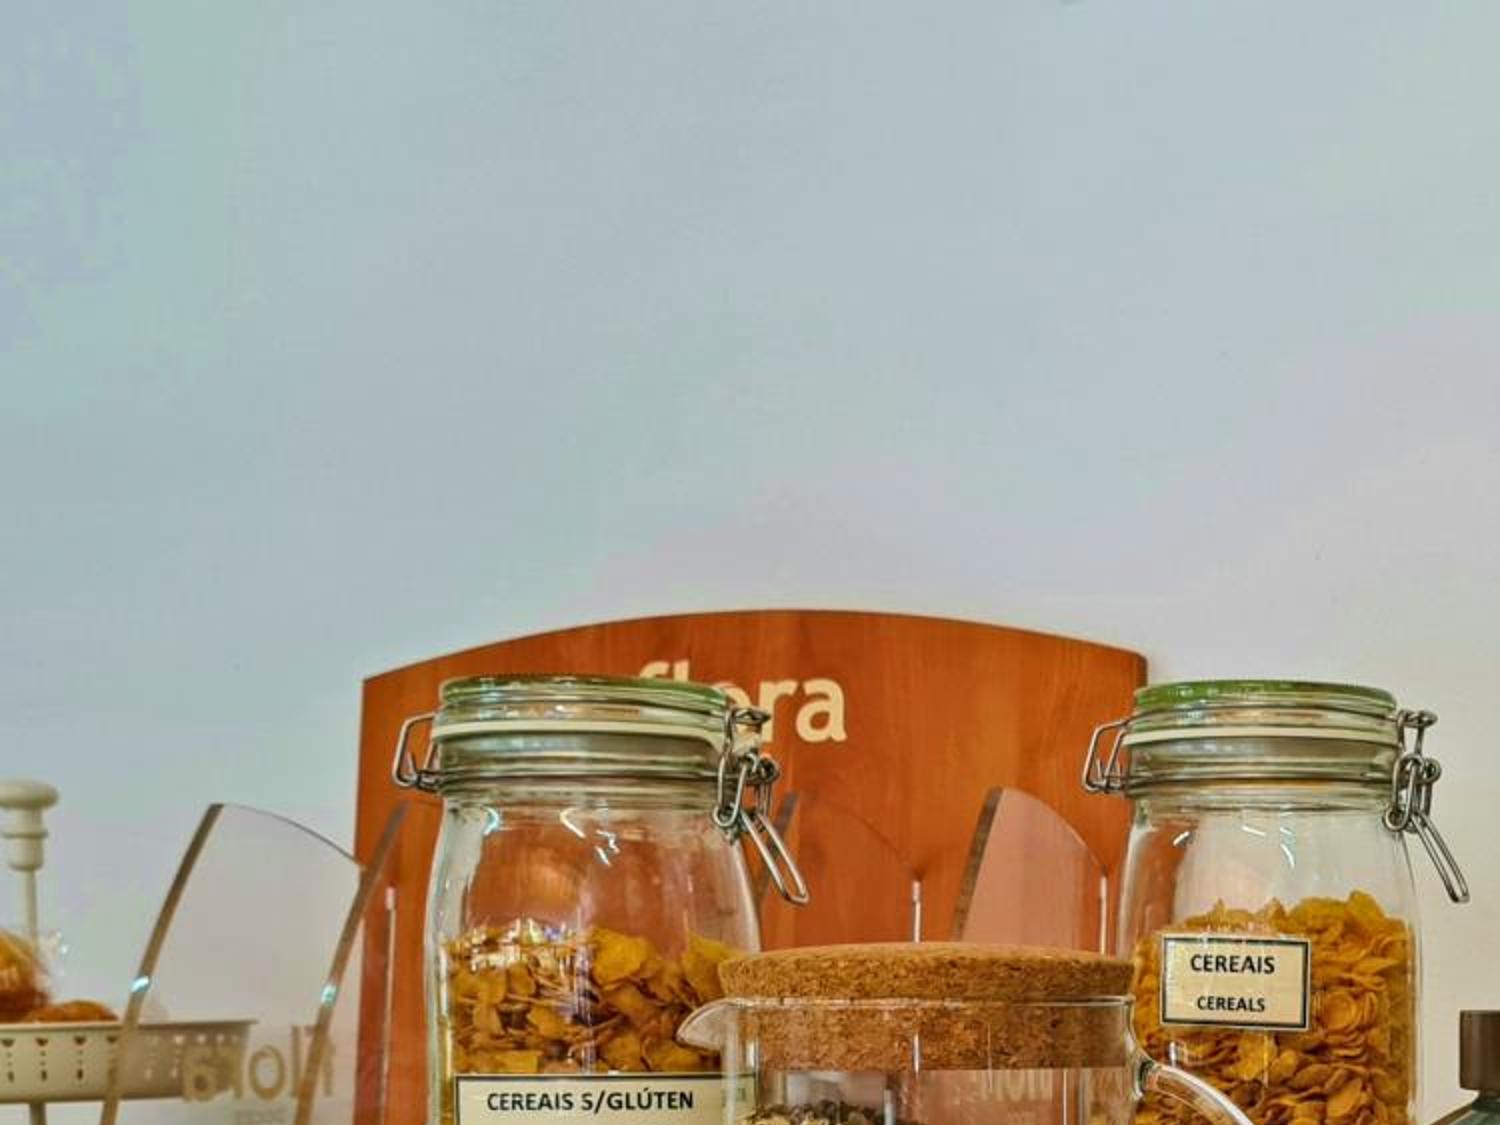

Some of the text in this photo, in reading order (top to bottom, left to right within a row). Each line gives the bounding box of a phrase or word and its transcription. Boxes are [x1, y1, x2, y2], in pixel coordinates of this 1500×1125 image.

[640, 660, 847, 743] ora
[1190, 954, 1275, 974] CEREAIS
[1197, 996, 1265, 1012] CEREALS
[487, 1087, 694, 1114] CEREAIS S/GLÚTEN
